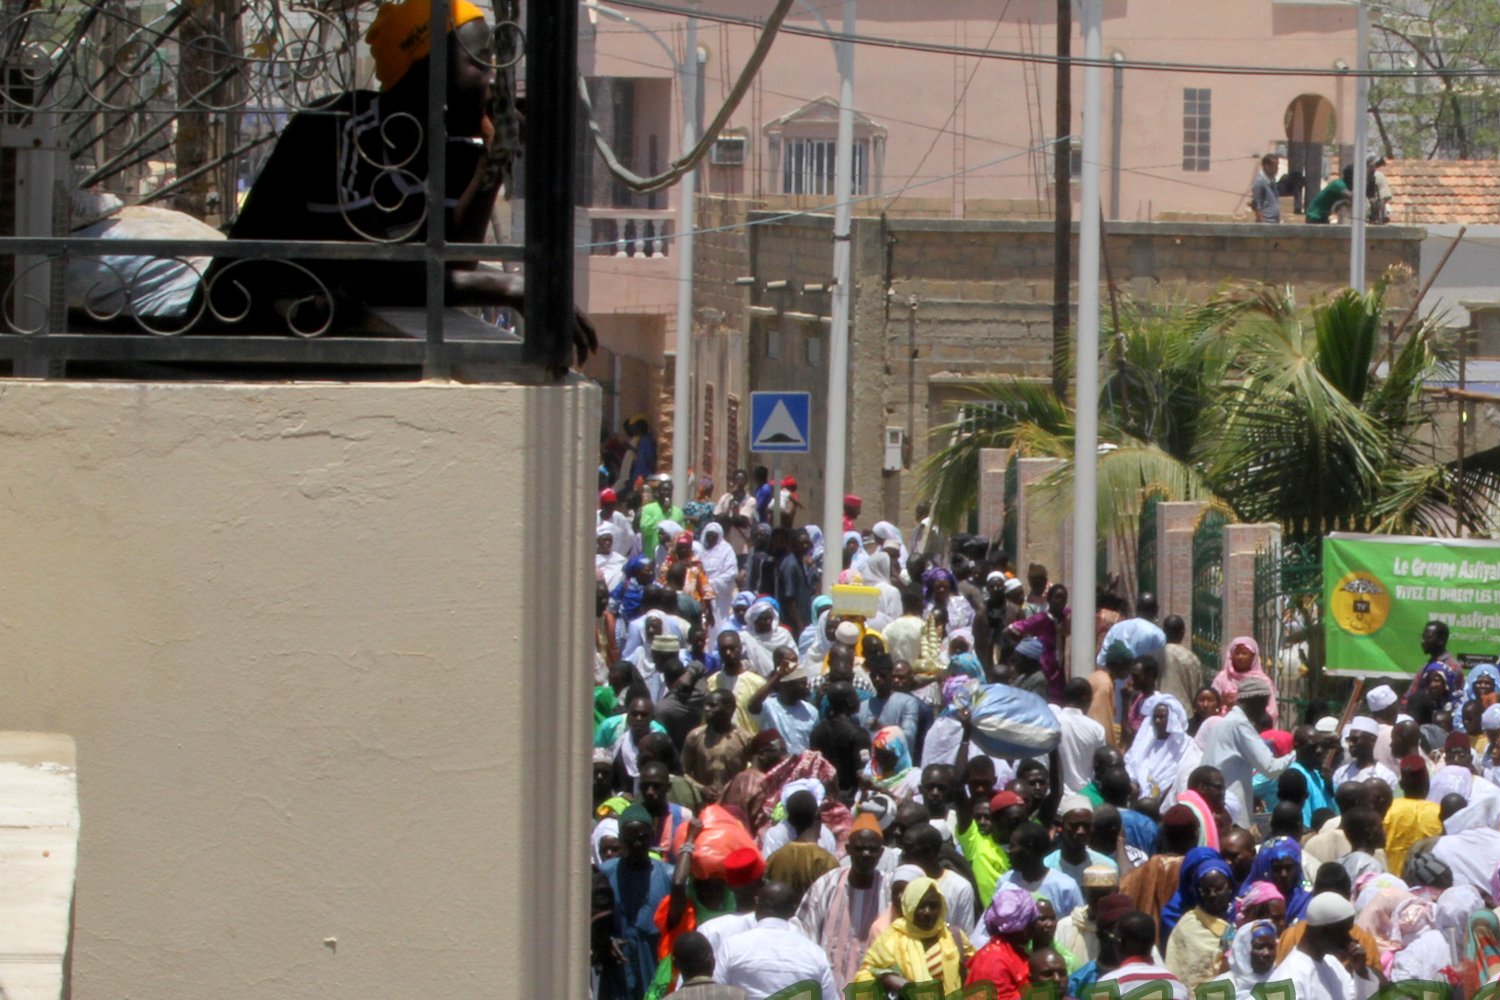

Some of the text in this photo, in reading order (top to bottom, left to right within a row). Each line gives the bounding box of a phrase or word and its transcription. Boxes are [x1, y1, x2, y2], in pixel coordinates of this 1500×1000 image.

[1393, 556, 1408, 576] Le
[1411, 557, 1457, 581] Groupe
[1396, 585, 1424, 600] VIVEZ
[1426, 586, 1439, 601] EN
[1440, 587, 1474, 603] DIRECT
[1475, 588, 1492, 604] LES
